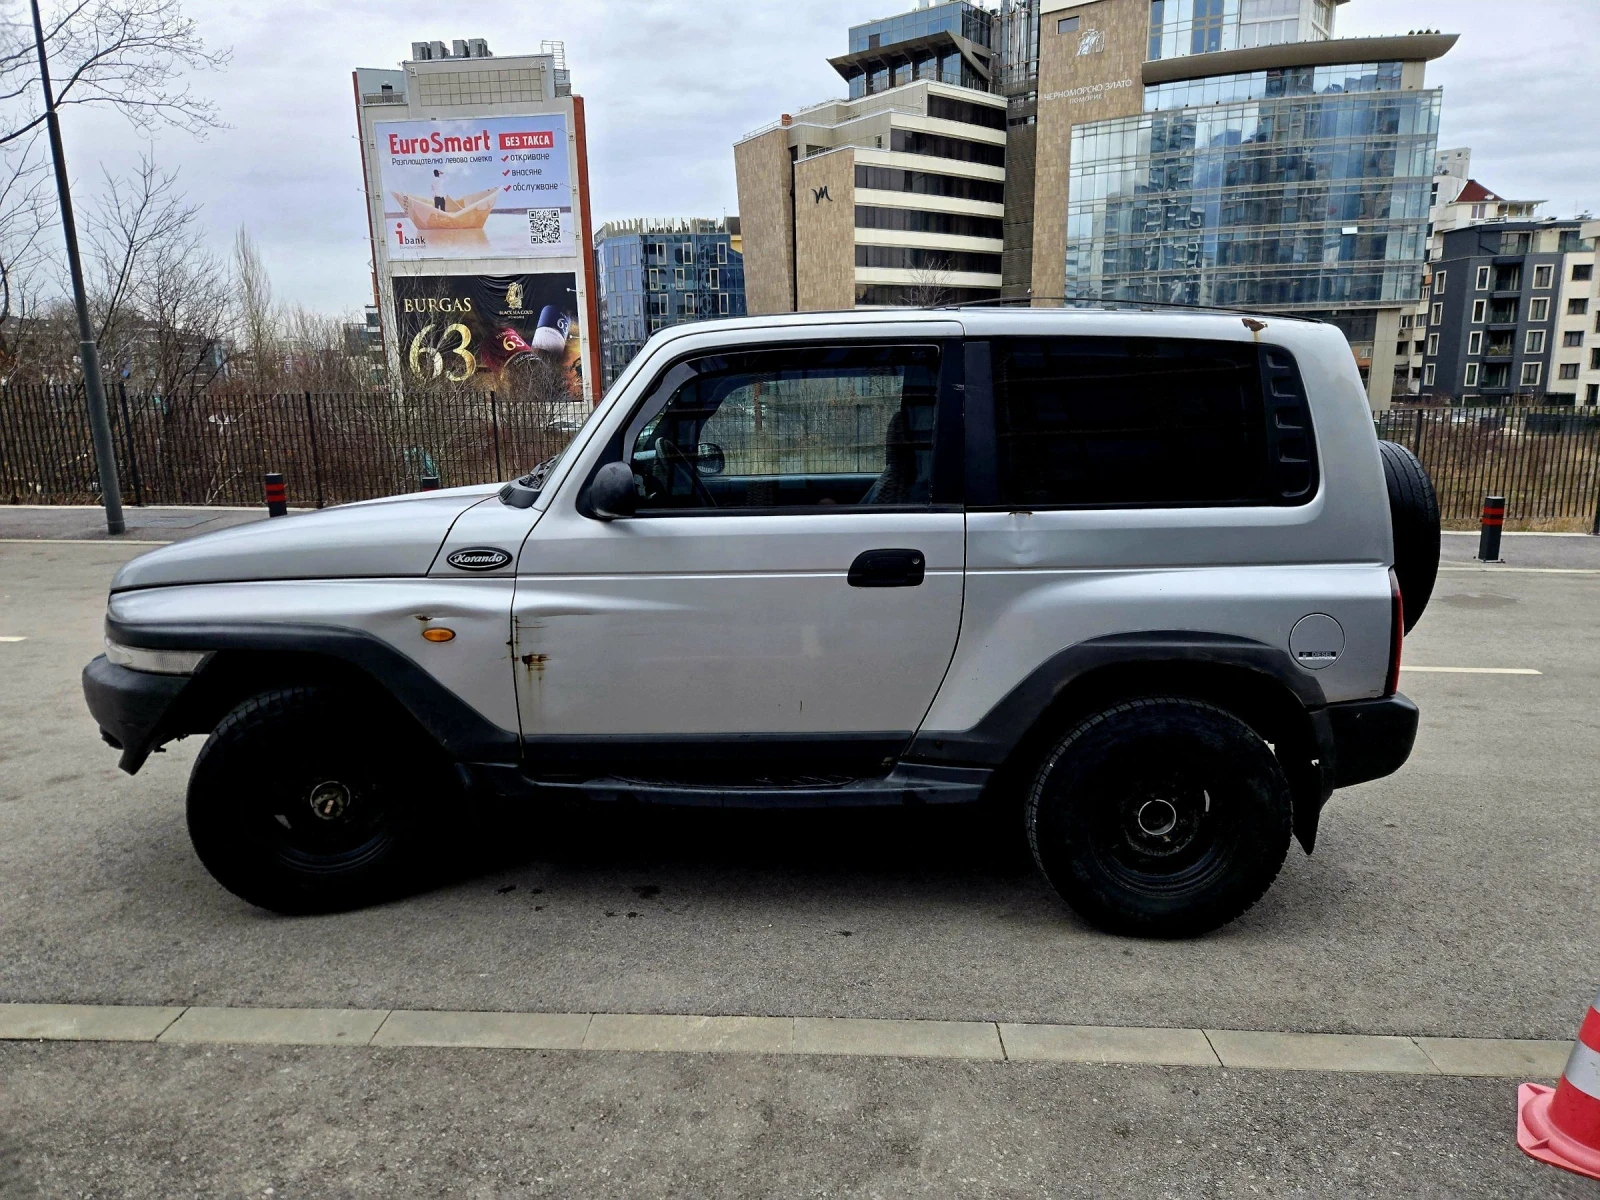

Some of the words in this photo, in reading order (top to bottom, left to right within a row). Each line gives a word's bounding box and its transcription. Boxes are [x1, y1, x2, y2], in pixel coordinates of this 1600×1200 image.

[1044, 84, 1103, 101] ЧЕРНОМОРСКО
[1105, 79, 1133, 91] ЗЛАТО
[1069, 94, 1102, 104] ПОМОРИЕ
[388, 129, 490, 155] EuroSmart
[505, 136, 520, 147] БЕЗ
[522, 135, 550, 146] ТАКСА
[445, 156, 468, 164] левова
[469, 155, 493, 163] сметка
[510, 152, 550, 163] откриване
[512, 182, 559, 193] обслужване
[403, 297, 472, 313] BURGAS
[503, 335, 525, 351] 63
[409, 323, 477, 382] 63
[454, 553, 503, 563] Korando
